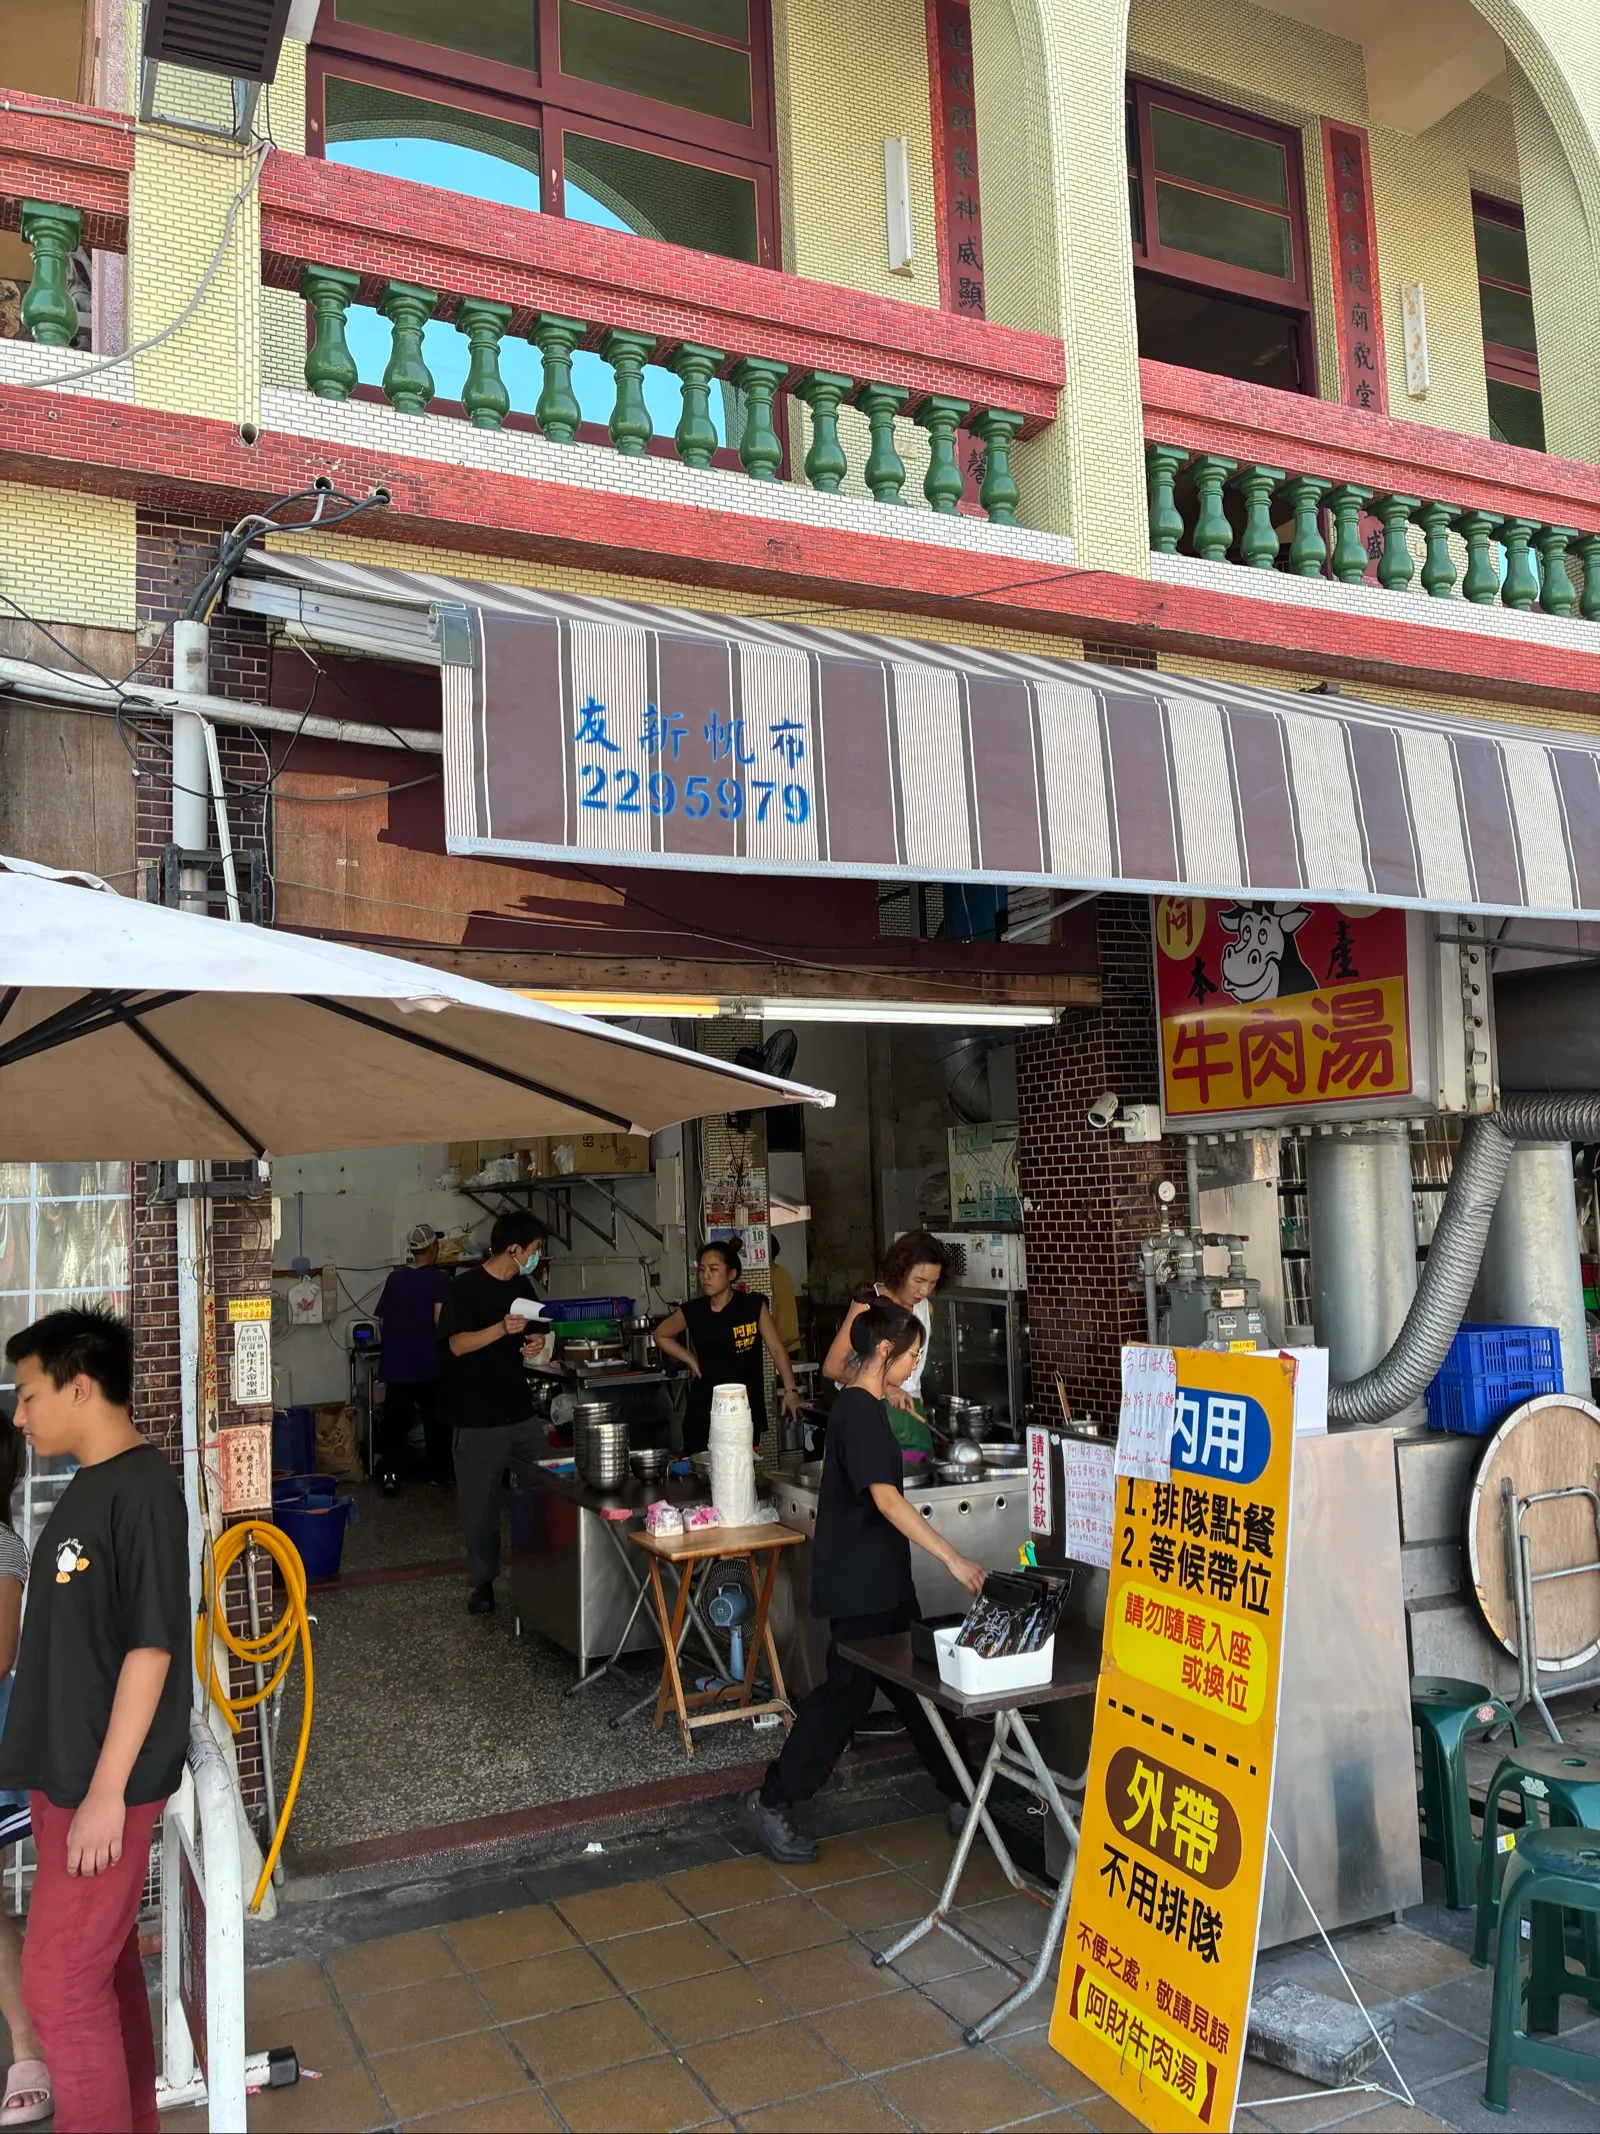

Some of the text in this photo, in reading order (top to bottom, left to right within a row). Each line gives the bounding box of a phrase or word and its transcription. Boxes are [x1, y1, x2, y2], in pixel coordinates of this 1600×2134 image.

[573, 696, 805, 769] 友新帆布
[580, 764, 810, 825] 2295979
[1188, 921, 1360, 1005] 本 產
[1172, 988, 1394, 1104] 牛肉湯
[753, 1230, 764, 1242] 18
[754, 1248, 766, 1260] 19
[205, 1302, 217, 1400] 南無阿彌陀佛
[733, 1322, 757, 1339] 阿財
[1172, 1391, 1247, 1474] 內用
[1031, 1433, 1047, 1529] 請先付款
[1124, 1591, 1252, 1671] 請勿隨意入座
[1181, 1653, 1250, 1713] 或換位
[1123, 1759, 1220, 1875] 外帶
[1100, 1843, 1224, 1964] 不用排隊
